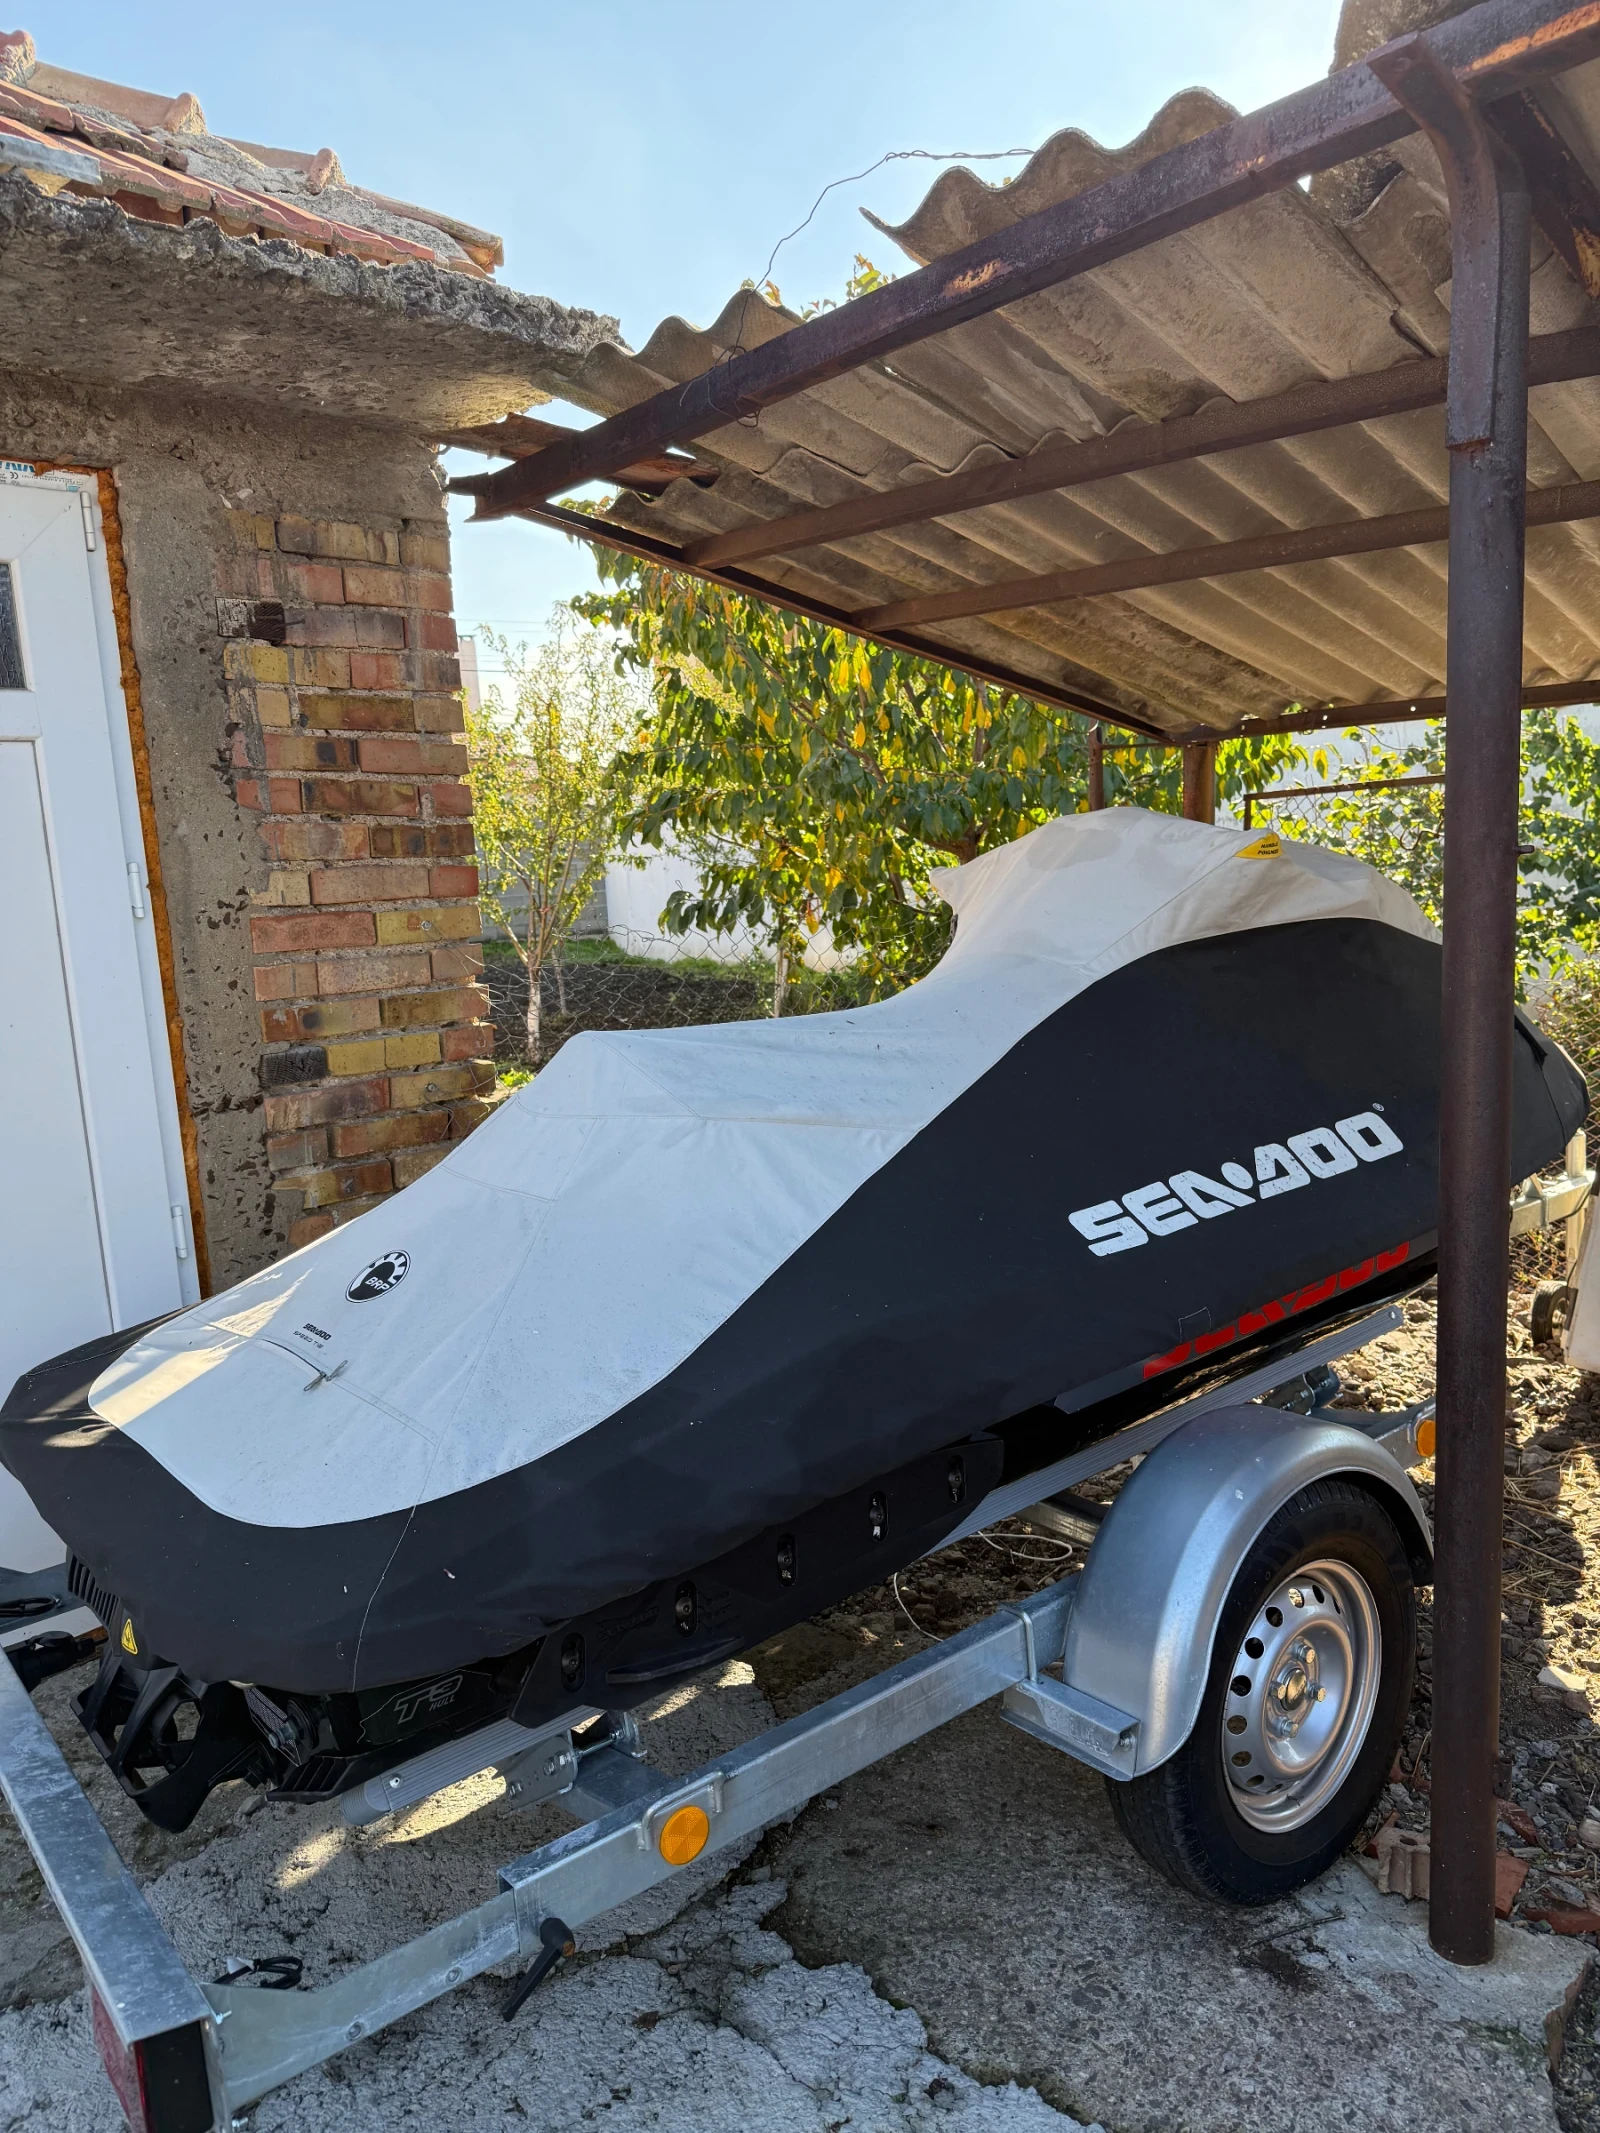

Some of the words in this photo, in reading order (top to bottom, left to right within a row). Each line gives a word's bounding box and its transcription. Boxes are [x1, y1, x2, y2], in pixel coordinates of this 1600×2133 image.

[364, 1276, 390, 1292] BRP
[394, 1674, 464, 1725] T3
[428, 1695, 456, 1712] HULL
